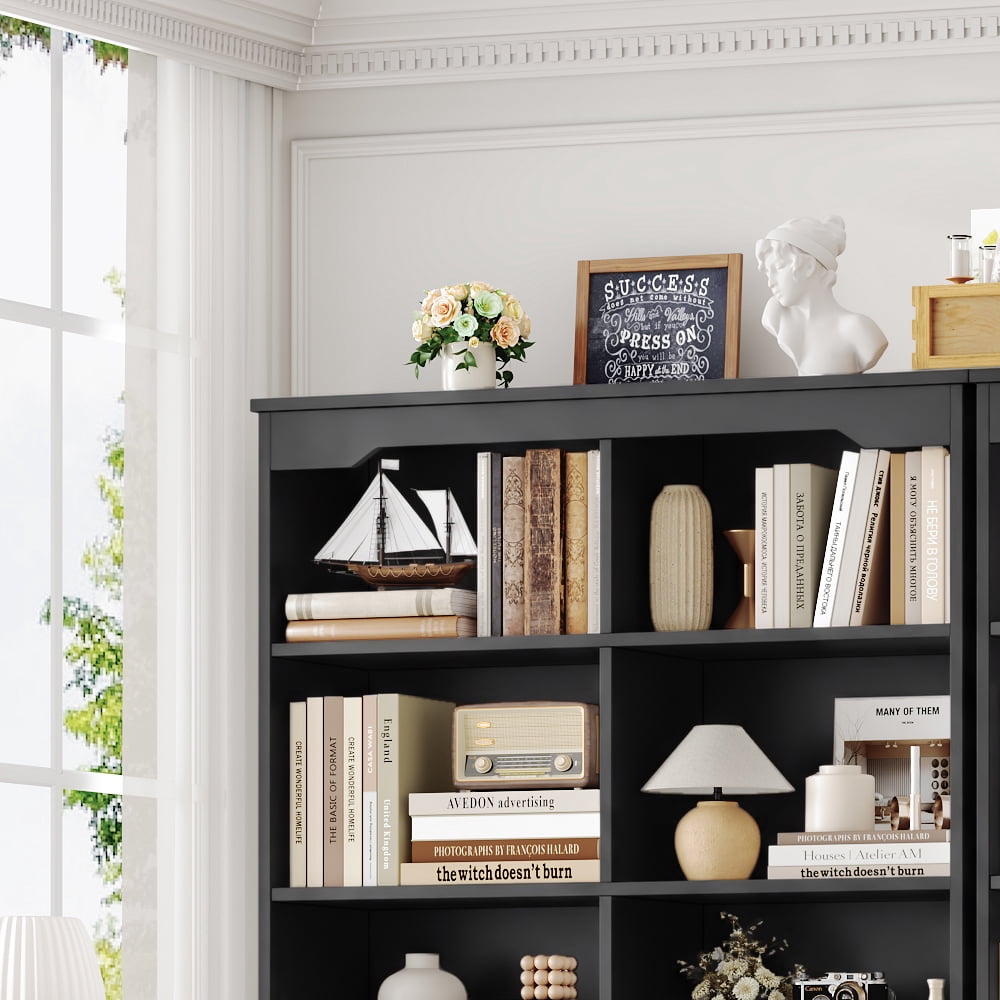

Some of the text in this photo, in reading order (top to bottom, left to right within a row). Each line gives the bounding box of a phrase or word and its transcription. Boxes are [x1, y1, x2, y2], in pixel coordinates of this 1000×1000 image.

[606, 299, 624, 310] does
[673, 294, 706, 305] without
[655, 321, 660, 330] if
[620, 325, 697, 350] PRESS ON
[638, 353, 648, 362] you
[652, 352, 664, 360] will
[624, 364, 654, 377] HAPPY
[671, 363, 690, 374] END
[796, 492, 805, 531] ЗАБОТА
[927, 500, 938, 514] НЕ
[927, 516, 938, 544] БЕРИ
[927, 548, 938, 556] В
[856, 512, 878, 613] Религия черной водолазки
[796, 544, 805, 610] ПРЕДАННЫХ
[927, 559, 938, 600] ГОЛОВУ
[876, 706, 940, 716] MANY OF THEM
[381, 718, 392, 763] England
[330, 779, 337, 792] OF
[447, 795, 555, 809] AVEDON advertising
[863, 833, 899, 842] FRANÇOIS
[382, 830, 391, 870] Kingdom
[434, 843, 580, 857] PHOTOGRAPHS BY FRANÇOIS HALARD
[804, 848, 922, 861] Houses Atelier AM
[436, 866, 456, 882] the
[458, 864, 493, 881] witch
[542, 864, 572, 879] burn
[800, 868, 819, 878] the
[820, 867, 851, 877] witch
[897, 866, 924, 876] burn
